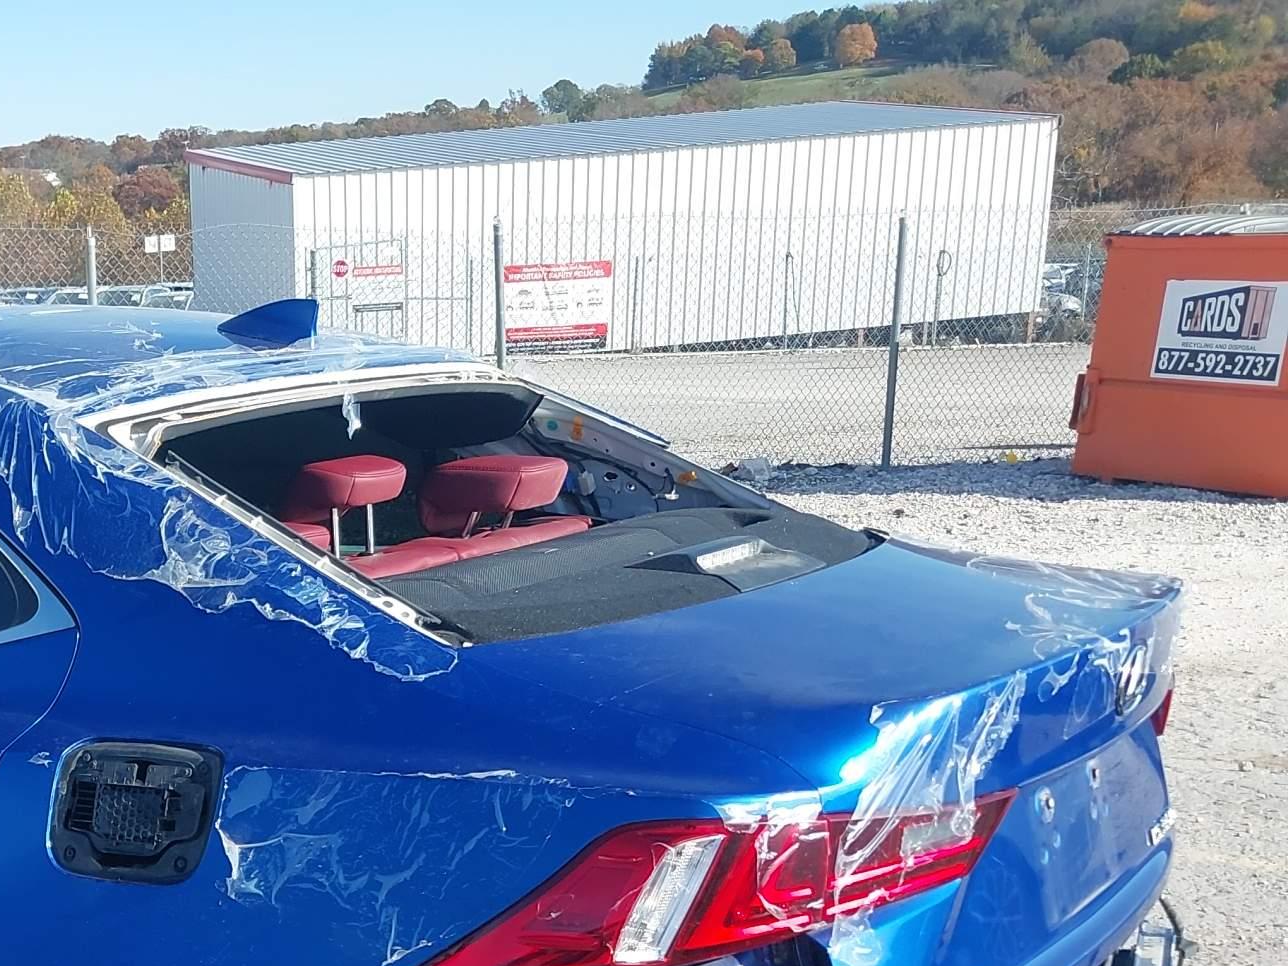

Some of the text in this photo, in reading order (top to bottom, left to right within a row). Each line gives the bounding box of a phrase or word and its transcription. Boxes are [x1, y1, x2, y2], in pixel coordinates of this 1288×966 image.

[332, 264, 349, 273] STOP
[1180, 292, 1246, 332] CARDS
[1181, 341, 1257, 352] RECYCLING AND DISPOSAL
[1158, 350, 1276, 377] 877-592-2737
